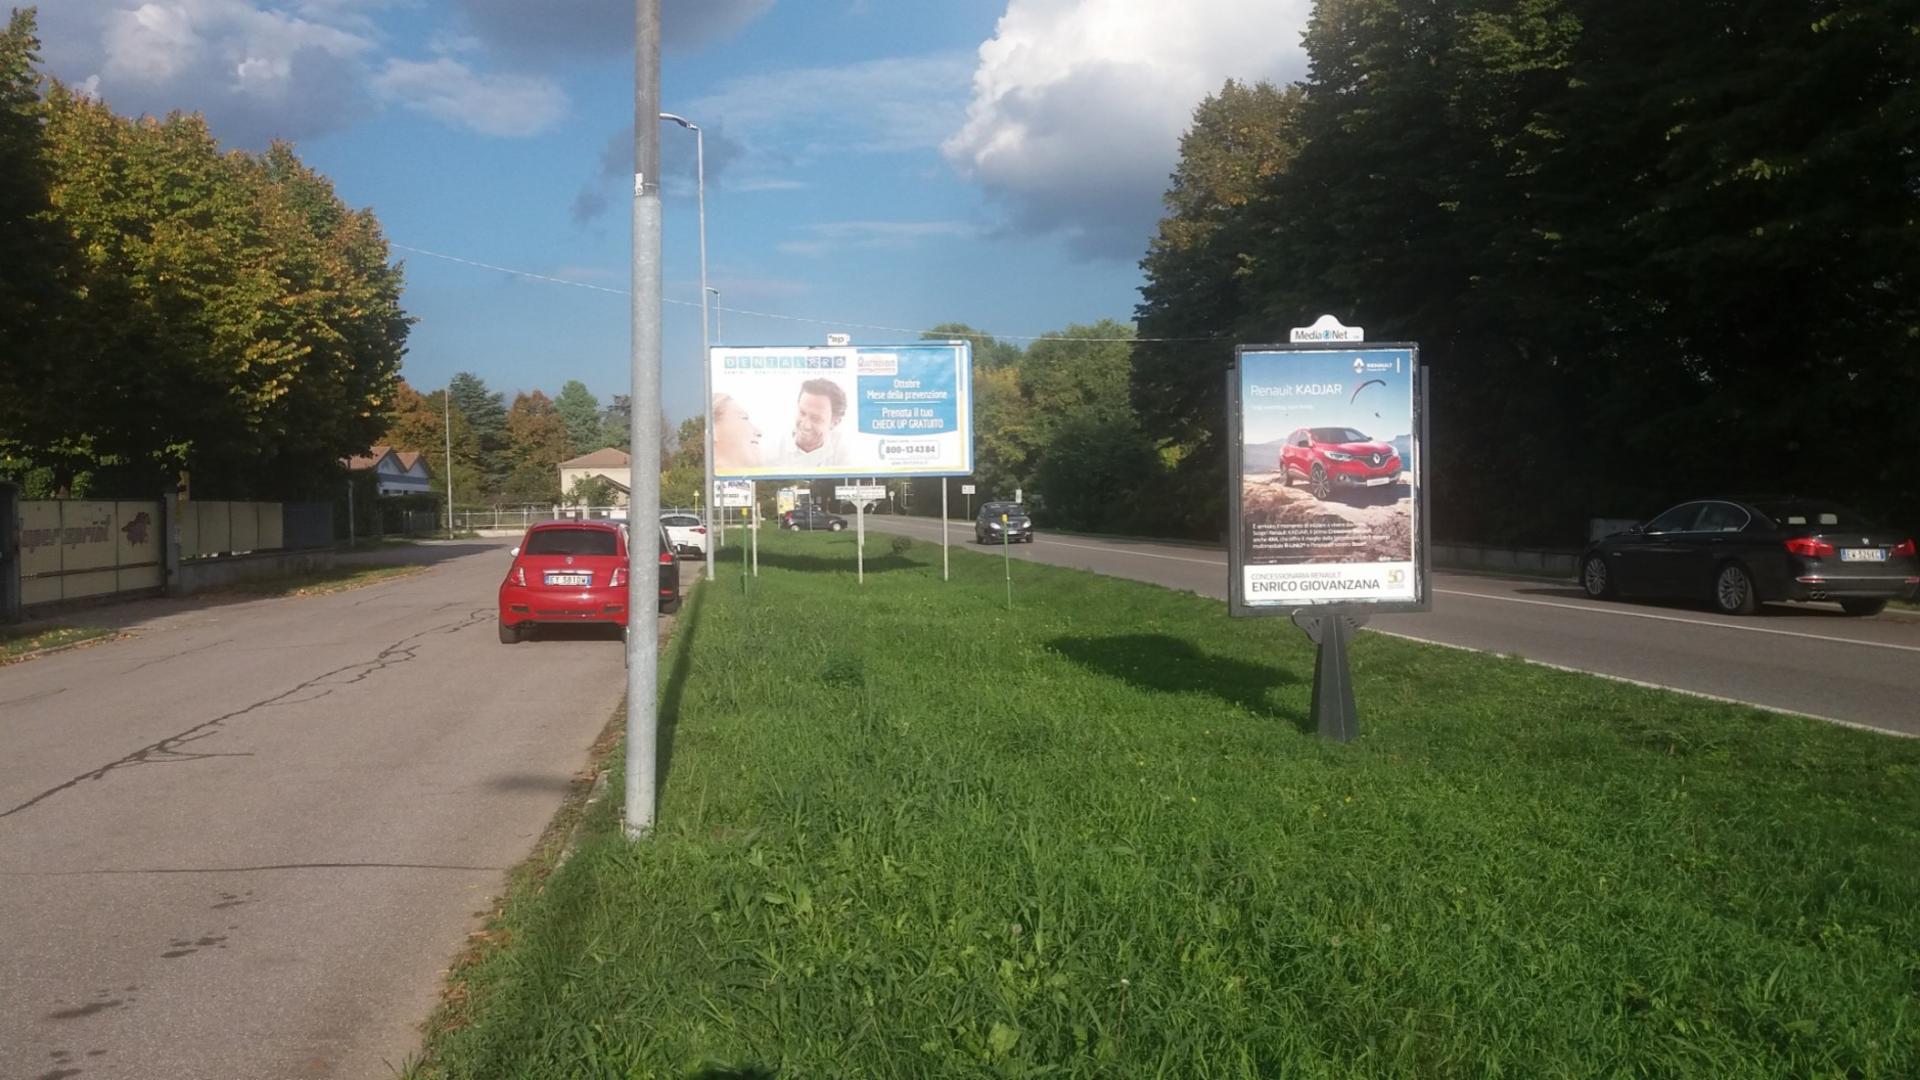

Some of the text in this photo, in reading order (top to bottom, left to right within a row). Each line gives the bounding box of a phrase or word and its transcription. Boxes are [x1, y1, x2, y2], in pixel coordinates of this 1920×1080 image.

[893, 379, 921, 389] Ottobre
[866, 389, 948, 401] Mese della prevenzione
[1250, 384, 1343, 397] Renault KADJAR
[881, 407, 912, 418] Prenota
[872, 418, 945, 429] CHECK UP GRATUITO
[1251, 571, 1342, 581] CONCESSIONARIA RENAULT
[1251, 578, 1381, 592] ENRICO GIOVANZANA
